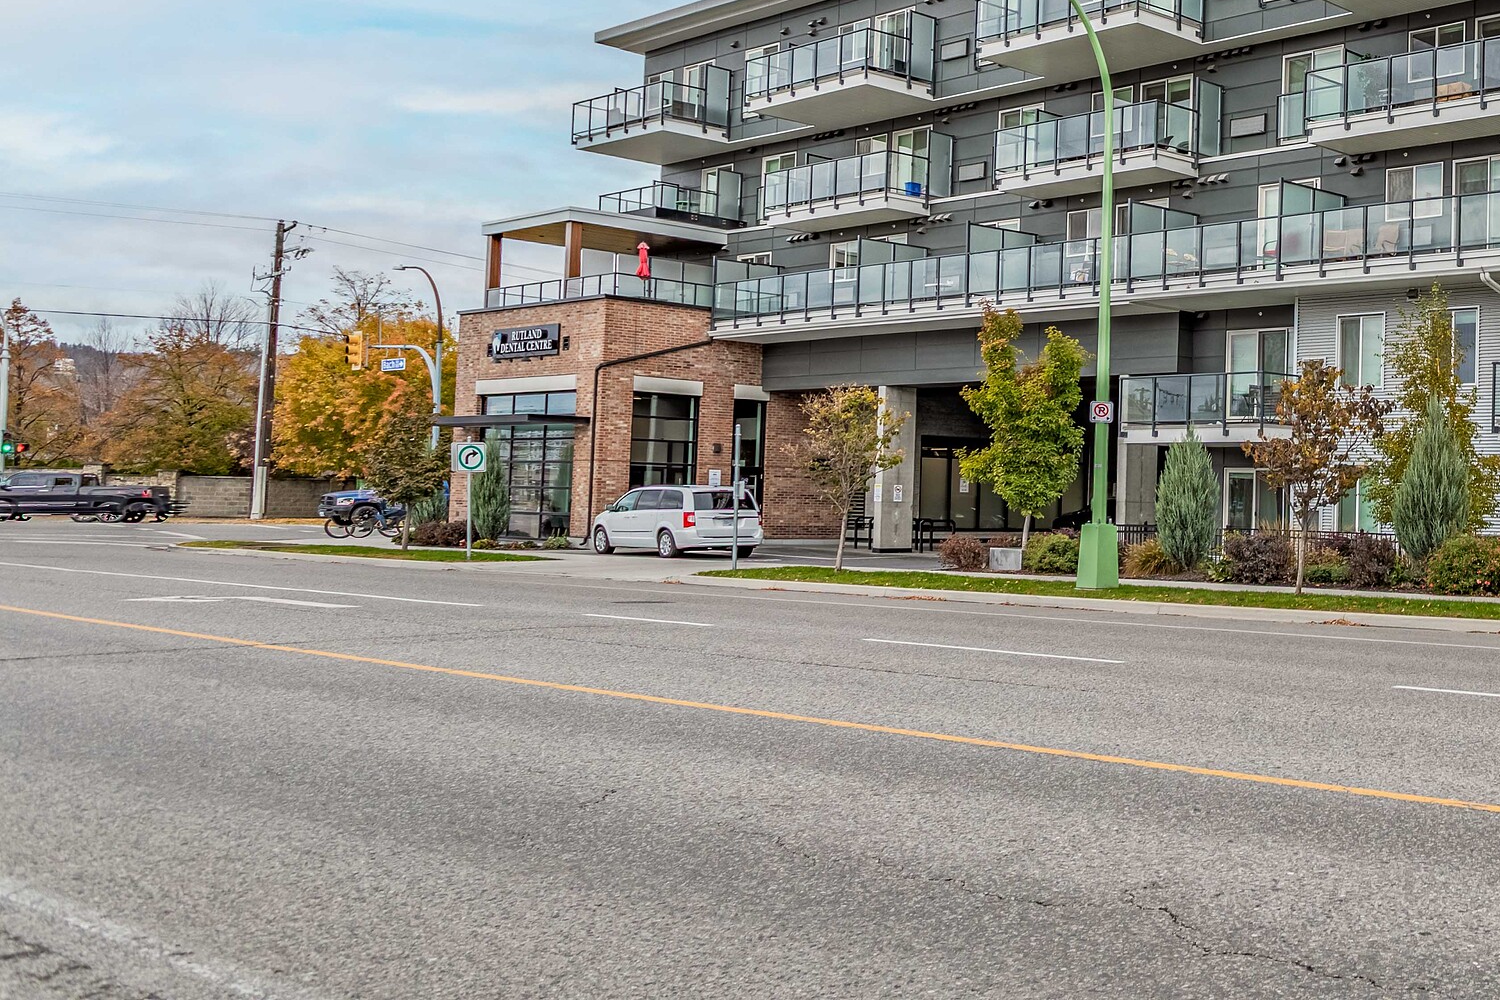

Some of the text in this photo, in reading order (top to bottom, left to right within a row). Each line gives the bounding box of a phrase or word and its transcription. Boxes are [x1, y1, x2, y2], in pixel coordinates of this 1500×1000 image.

[511, 329, 541, 340] RUTLAND
[501, 340, 552, 353] DENTAL CENTRE
